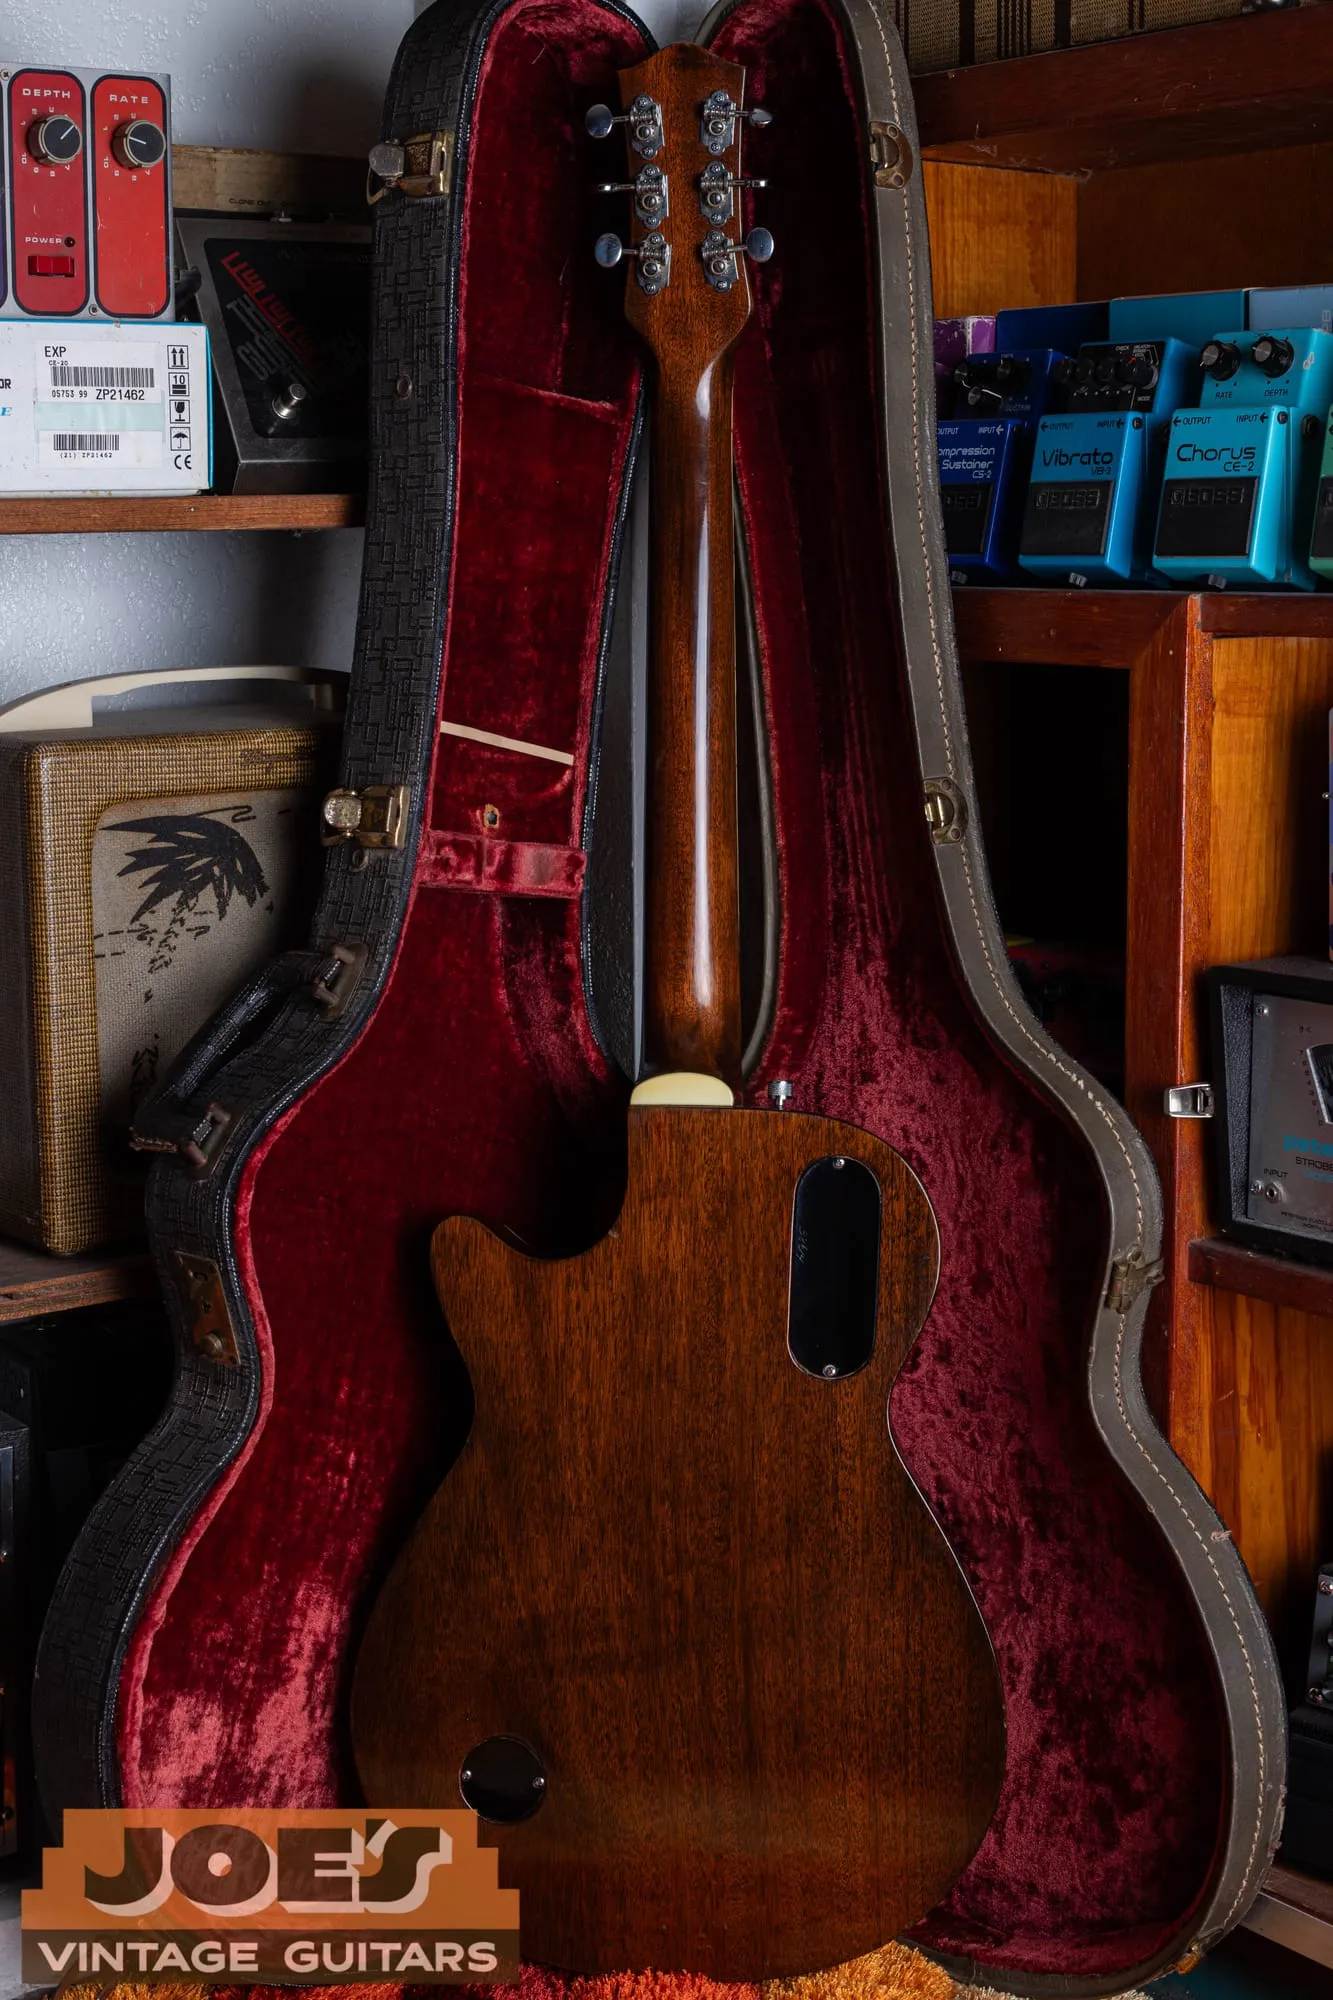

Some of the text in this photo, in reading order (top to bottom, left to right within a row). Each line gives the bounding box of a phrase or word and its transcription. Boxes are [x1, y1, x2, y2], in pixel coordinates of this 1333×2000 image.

[22, 88, 71, 98] DEPTH
[109, 94, 149, 104] RATE
[24, 236, 62, 244] POWER
[44, 346, 67, 358] EXP
[174, 375, 186, 385] 10
[51, 389, 145, 400] 05753 99 ZP21462
[1215, 390, 1233, 400] RATE
[1264, 388, 1288, 397] DEPTH
[1182, 415, 1212, 425] OUTPUT
[1235, 413, 1258, 423] INPUT
[978, 426, 996, 434] INPUT
[938, 444, 995, 459] ompression
[1176, 443, 1257, 462] Chorus
[1041, 447, 1114, 467] Vibrato
[941, 459, 994, 470] Sustainer
[1223, 461, 1255, 472] CE-2
[972, 470, 992, 479] CS-2
[1263, 1168, 1289, 1180] INPUT
